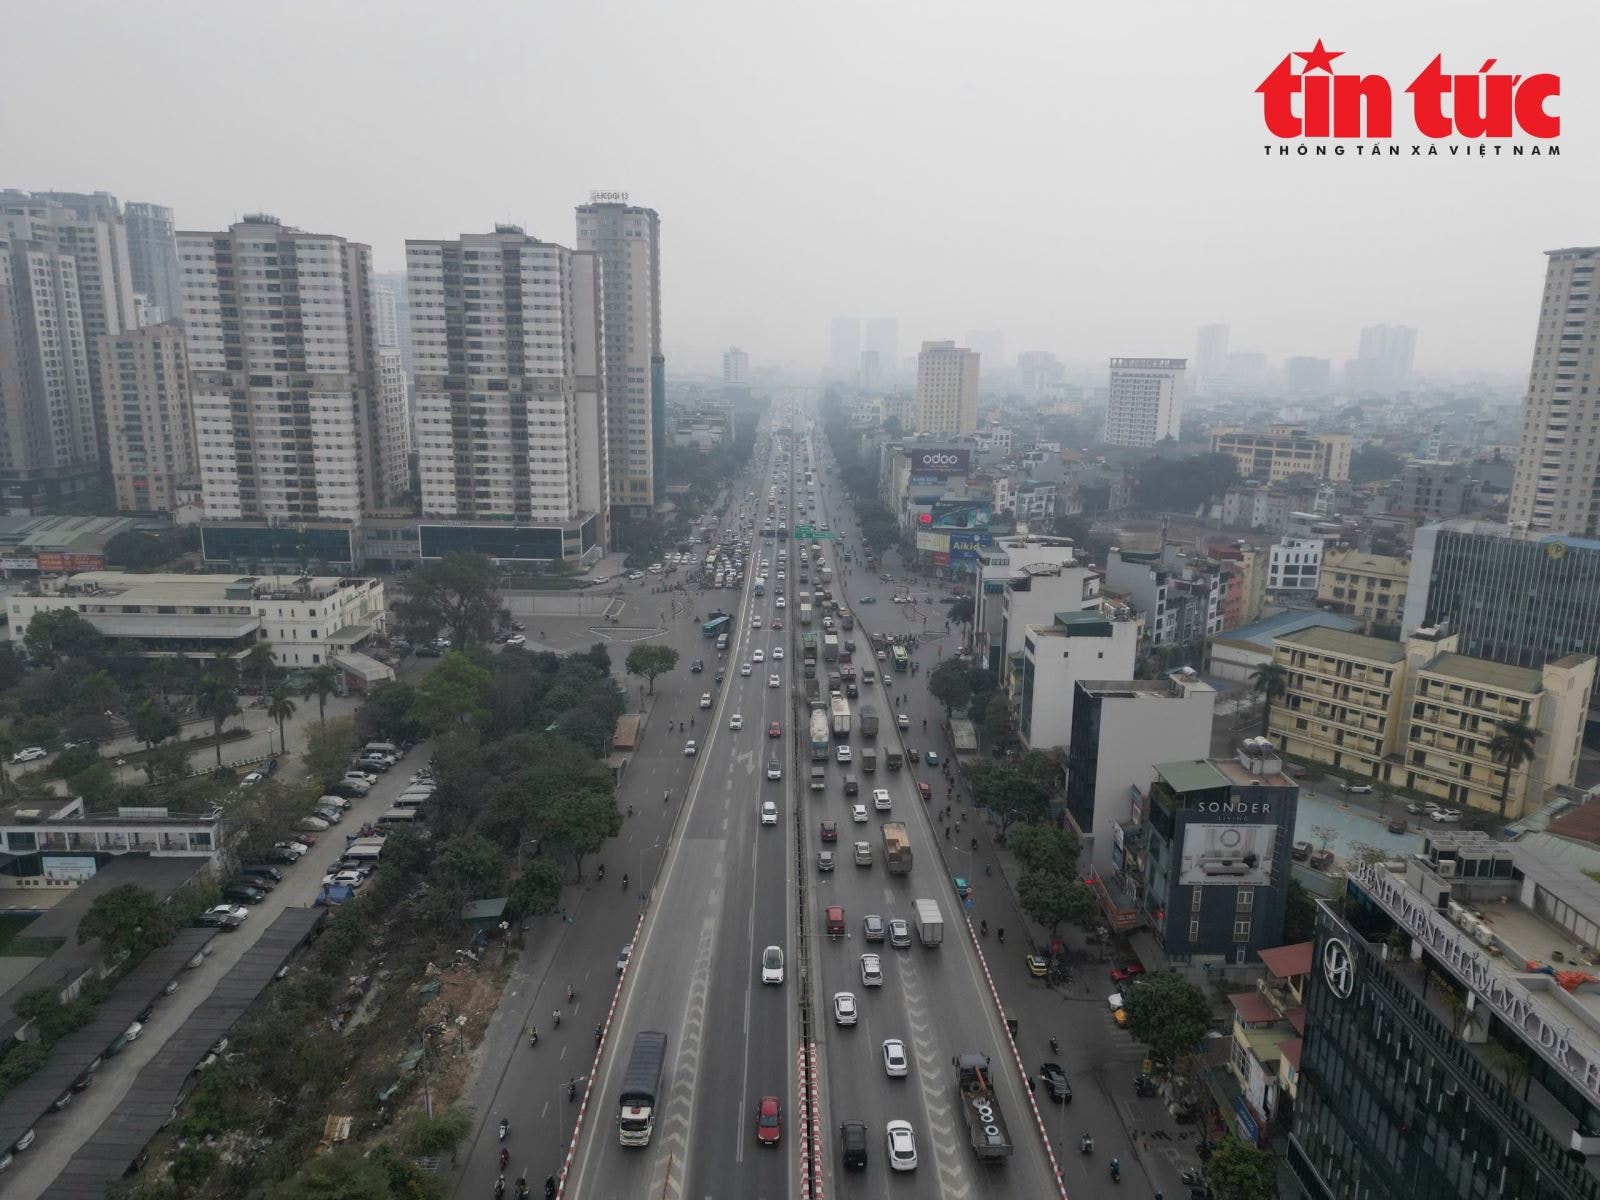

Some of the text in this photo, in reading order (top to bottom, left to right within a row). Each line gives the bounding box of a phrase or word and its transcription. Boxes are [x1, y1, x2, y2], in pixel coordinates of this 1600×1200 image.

[923, 452, 957, 464] odoo
[1198, 802, 1271, 814] SONDER
[1357, 861, 1398, 908] BỆNH
[1400, 896, 1440, 947] VIỆN
[1441, 932, 1497, 1000] THẨM
[1537, 1018, 1576, 1073] DR.
